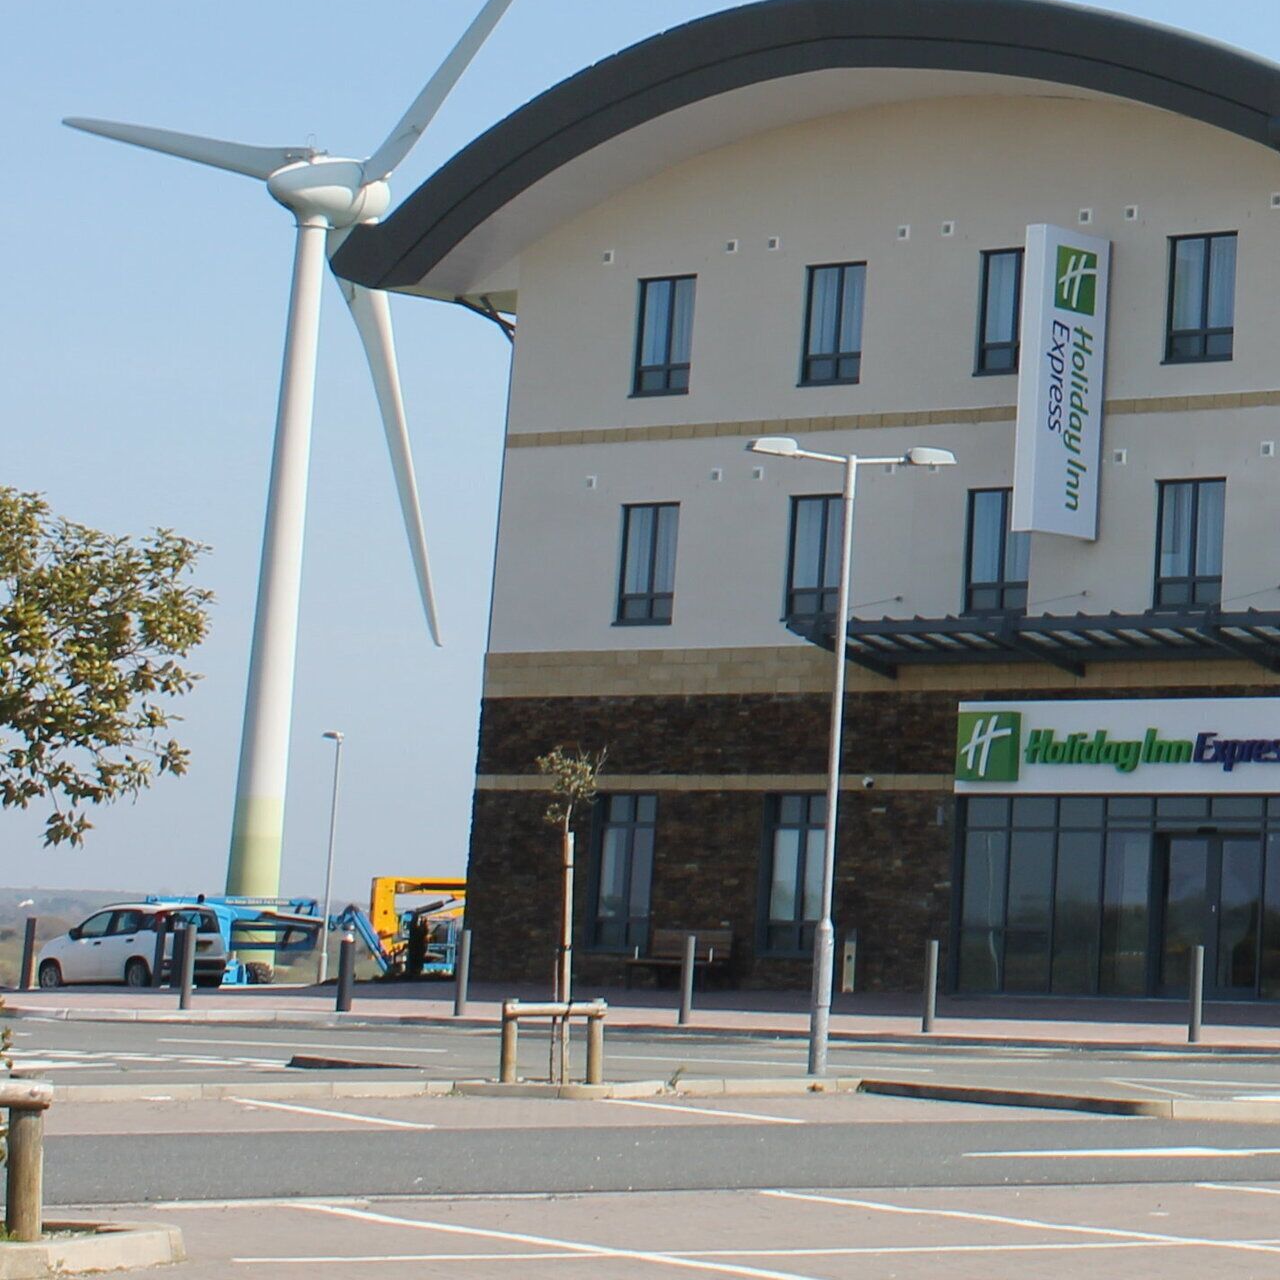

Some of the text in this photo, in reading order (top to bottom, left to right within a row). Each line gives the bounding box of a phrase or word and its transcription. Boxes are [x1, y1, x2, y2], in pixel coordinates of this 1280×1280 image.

[1047, 320, 1070, 434] Express
[1063, 325, 1093, 512] Holiday Inn
[1024, 728, 1143, 772] Holiday
[1141, 727, 1193, 764] Inn
